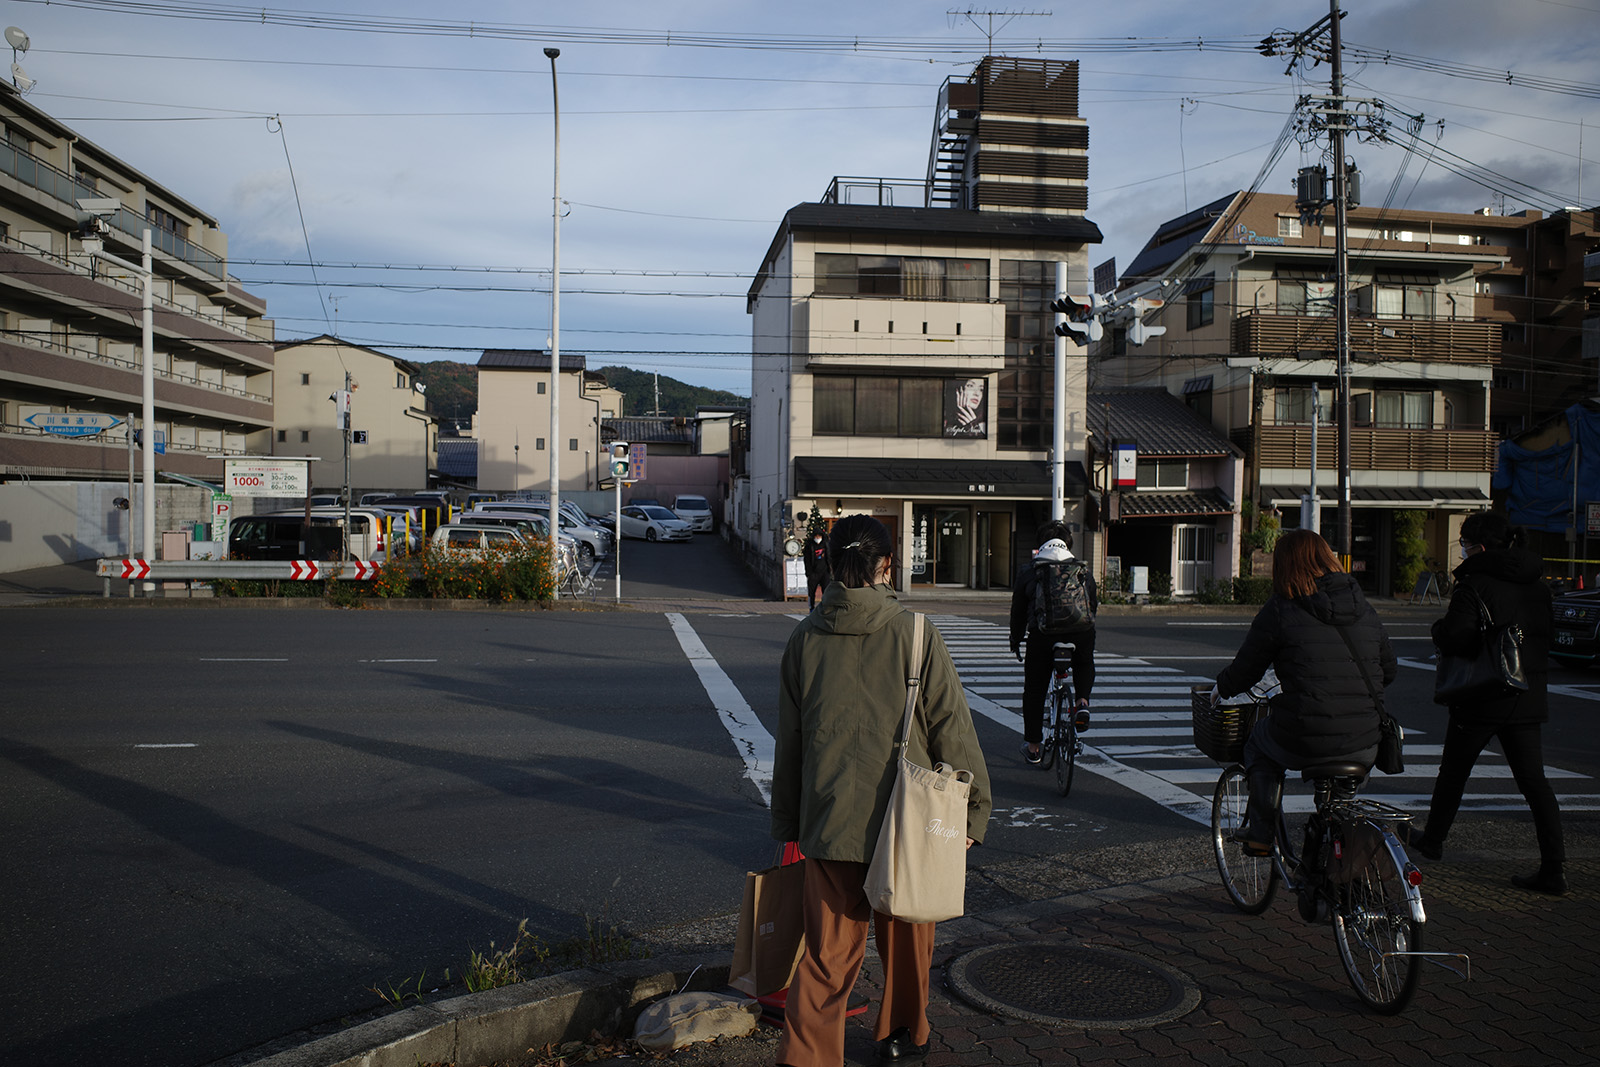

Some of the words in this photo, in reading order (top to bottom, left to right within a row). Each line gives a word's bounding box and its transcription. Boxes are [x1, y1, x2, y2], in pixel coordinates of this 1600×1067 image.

[47, 416, 98, 425] 川端通り
[217, 504, 229, 515] P
